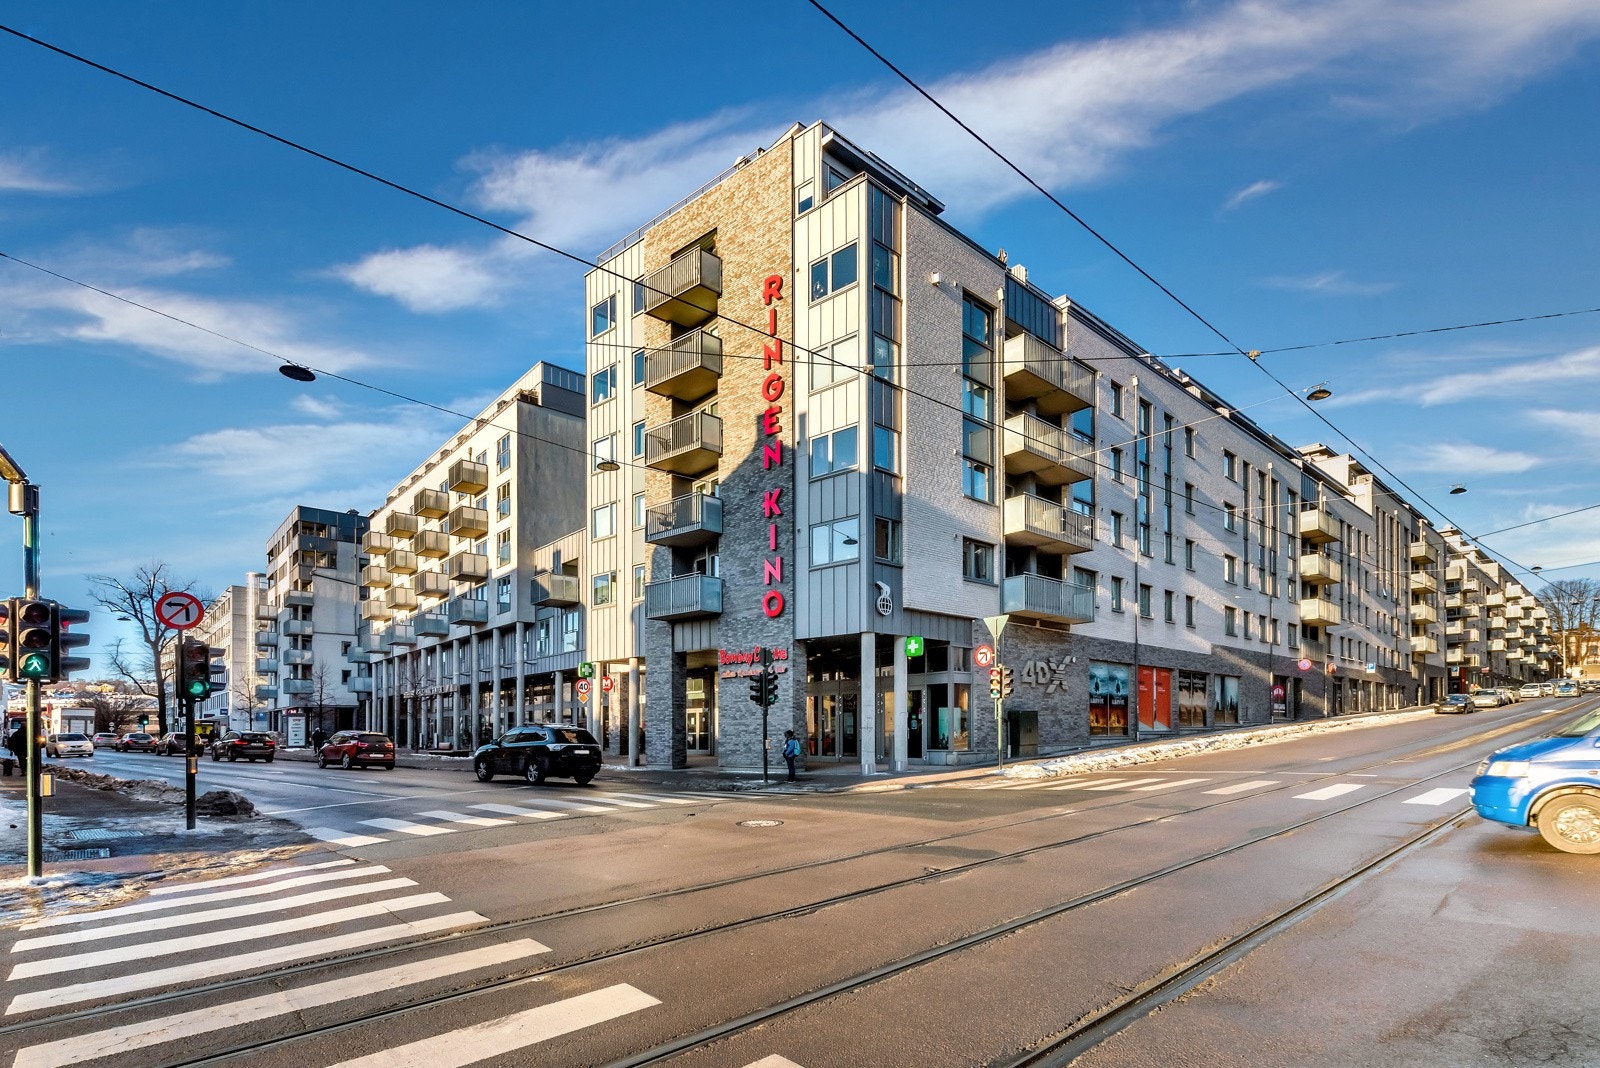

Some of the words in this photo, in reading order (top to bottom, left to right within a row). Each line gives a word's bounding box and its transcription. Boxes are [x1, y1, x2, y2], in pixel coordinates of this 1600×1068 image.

[762, 274, 785, 470] RINGEN
[762, 488, 784, 618] KINO
[719, 649, 753, 666] Bombay
[1021, 655, 1072, 694] 4DX
[579, 682, 589, 690] 40
